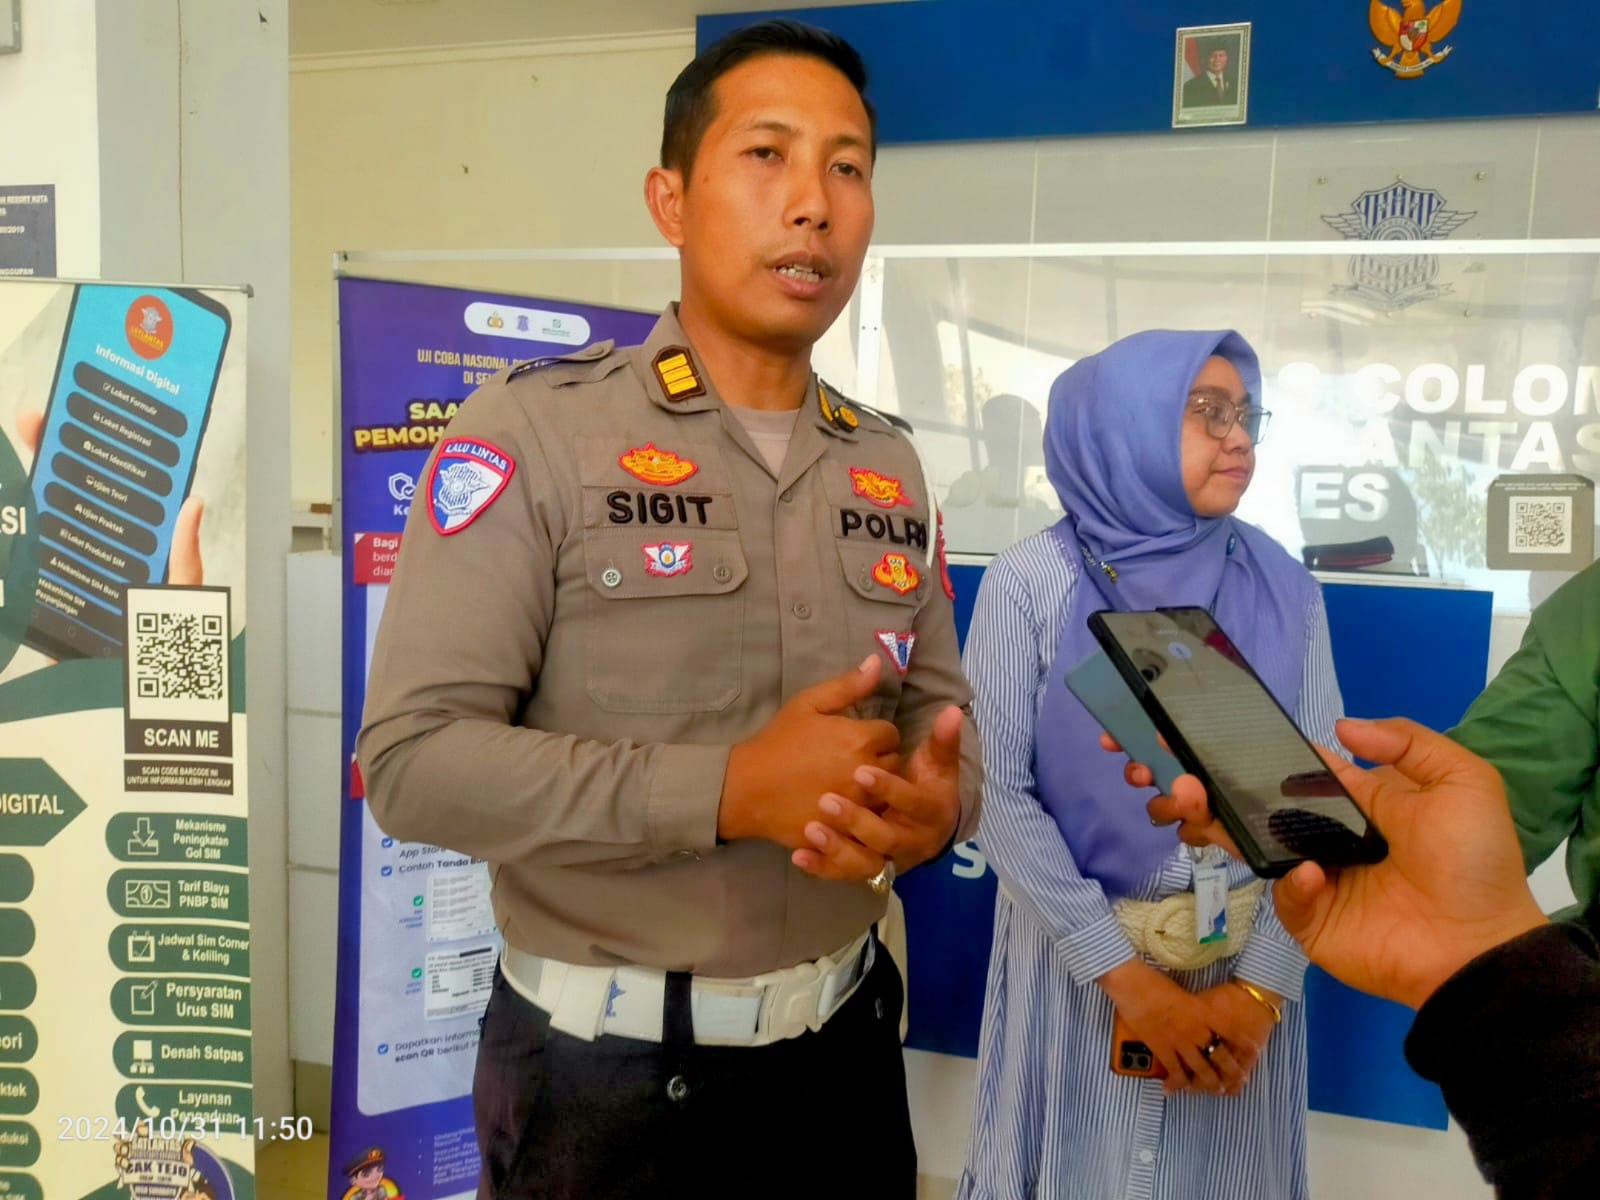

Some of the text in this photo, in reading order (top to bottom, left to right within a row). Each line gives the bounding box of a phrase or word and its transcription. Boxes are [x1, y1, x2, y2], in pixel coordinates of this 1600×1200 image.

[417, 349, 432, 363] UJI
[434, 351, 461, 366] COBA
[95, 343, 180, 395] Informasi Digital
[463, 371, 494, 385] DI SE
[445, 442, 508, 470] LALU LINTAS
[1298, 469, 1390, 523] ES
[606, 490, 713, 525] SIGIT
[840, 508, 927, 550] POLRI
[373, 537, 398, 550] Bagi
[144, 728, 219, 748] SCAN ME
[142, 766, 160, 775] SCAN
[179, 767, 209, 776] BARCODE
[127, 776, 149, 785] UNTUK
[149, 776, 185, 785] INFORMASI
[0, 793, 65, 815] IGITAL
[175, 818, 226, 833] Mekanisme
[173, 832, 230, 847] Peningkatan
[185, 846, 221, 859] Gol SIM
[399, 848, 419, 859] App
[398, 861, 434, 873] Contoh
[437, 859, 469, 868] Tanda
[178, 879, 230, 896] Tarif Biaya
[179, 895, 229, 910] PNBP SIM
[158, 932, 249, 951] Jadwal Sim Corner
[182, 948, 230, 966] & Keliling
[166, 982, 242, 1002] Persyaratan
[176, 1001, 234, 1020] Urus SIM
[395, 1037, 443, 1051] Dapatkan
[161, 1044, 244, 1065] Denah Satpas
[395, 1051, 419, 1063] scan
[420, 1048, 434, 1058] QR
[178, 1089, 232, 1108] Layanan
[170, 1107, 240, 1126] Pengaduan
